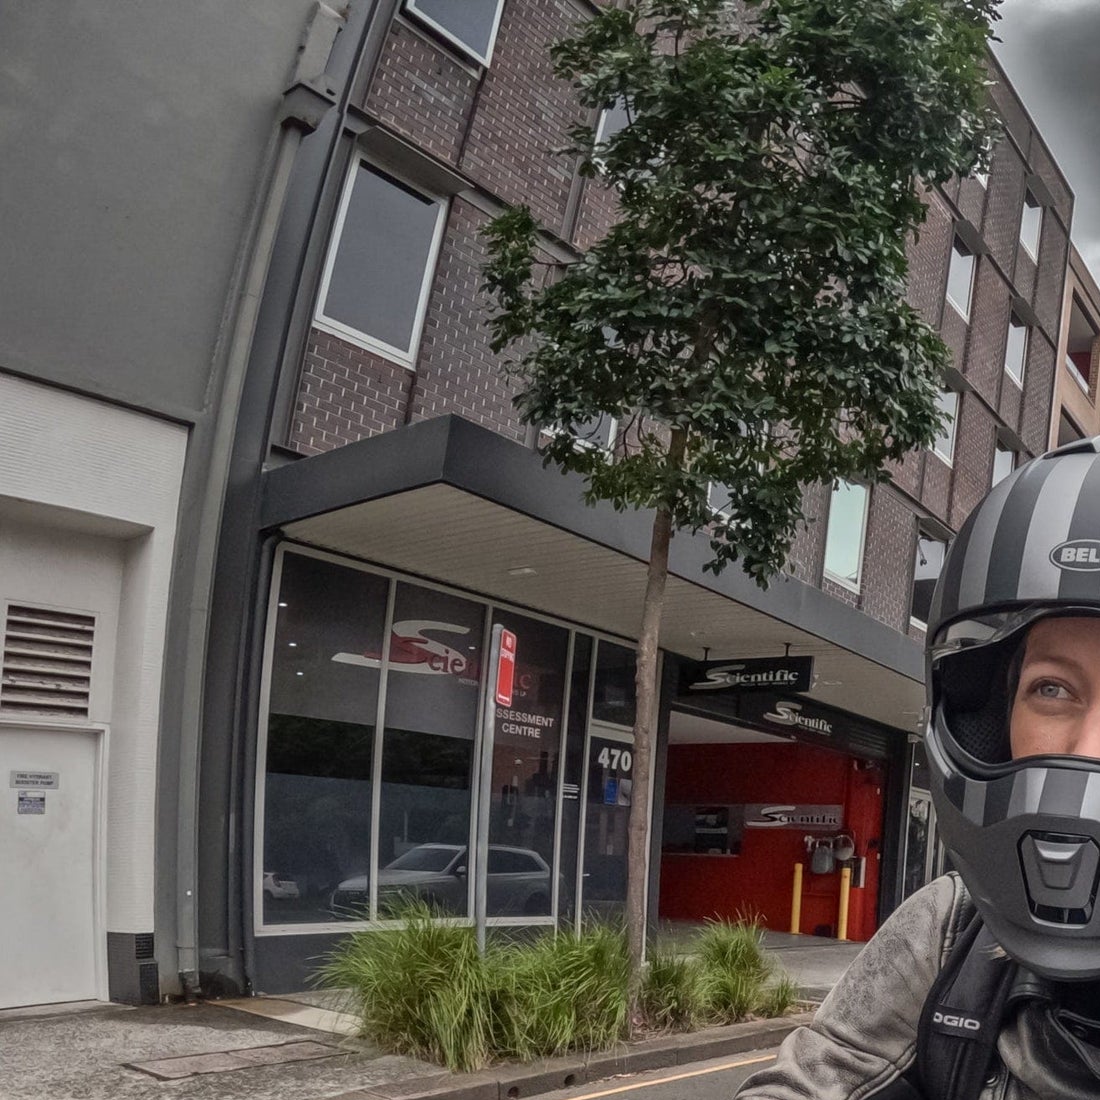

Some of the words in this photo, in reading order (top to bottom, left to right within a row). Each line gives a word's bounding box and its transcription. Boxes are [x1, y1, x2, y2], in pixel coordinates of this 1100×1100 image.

[689, 664, 799, 690] Scientific
[496, 708, 554, 727] SSESSMENT
[502, 723, 541, 738] CENTRE
[598, 747, 632, 771] 470
